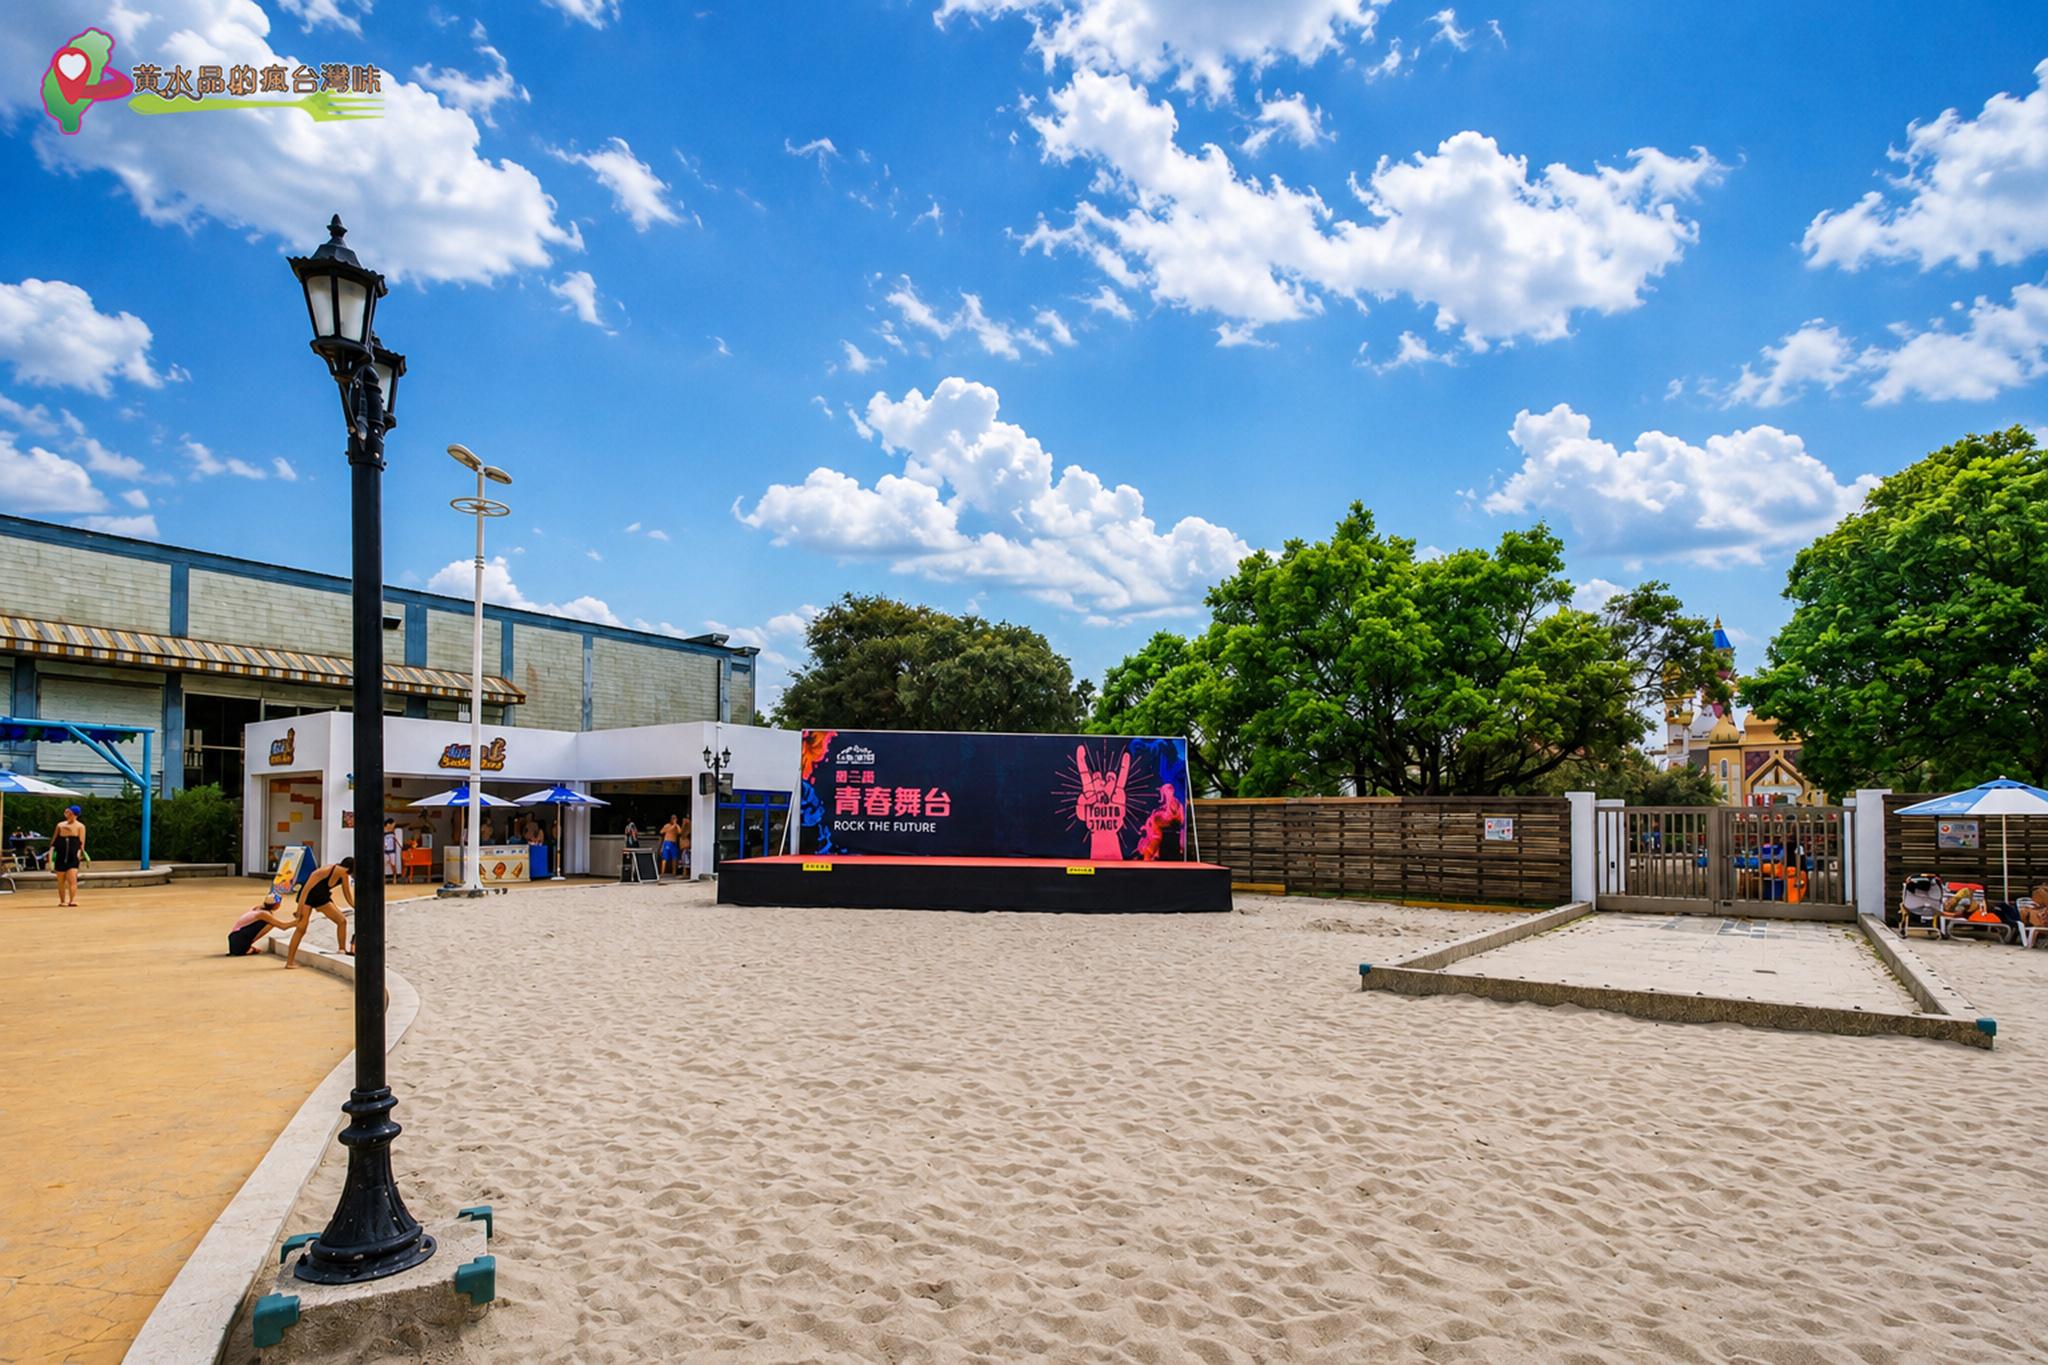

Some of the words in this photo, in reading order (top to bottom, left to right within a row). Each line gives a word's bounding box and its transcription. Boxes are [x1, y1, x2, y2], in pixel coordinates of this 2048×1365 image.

[834, 786, 951, 817] 青春舞台
[834, 821, 865, 831] ROCK
[869, 821, 890, 832] THE
[894, 822, 936, 832] FUTURE
